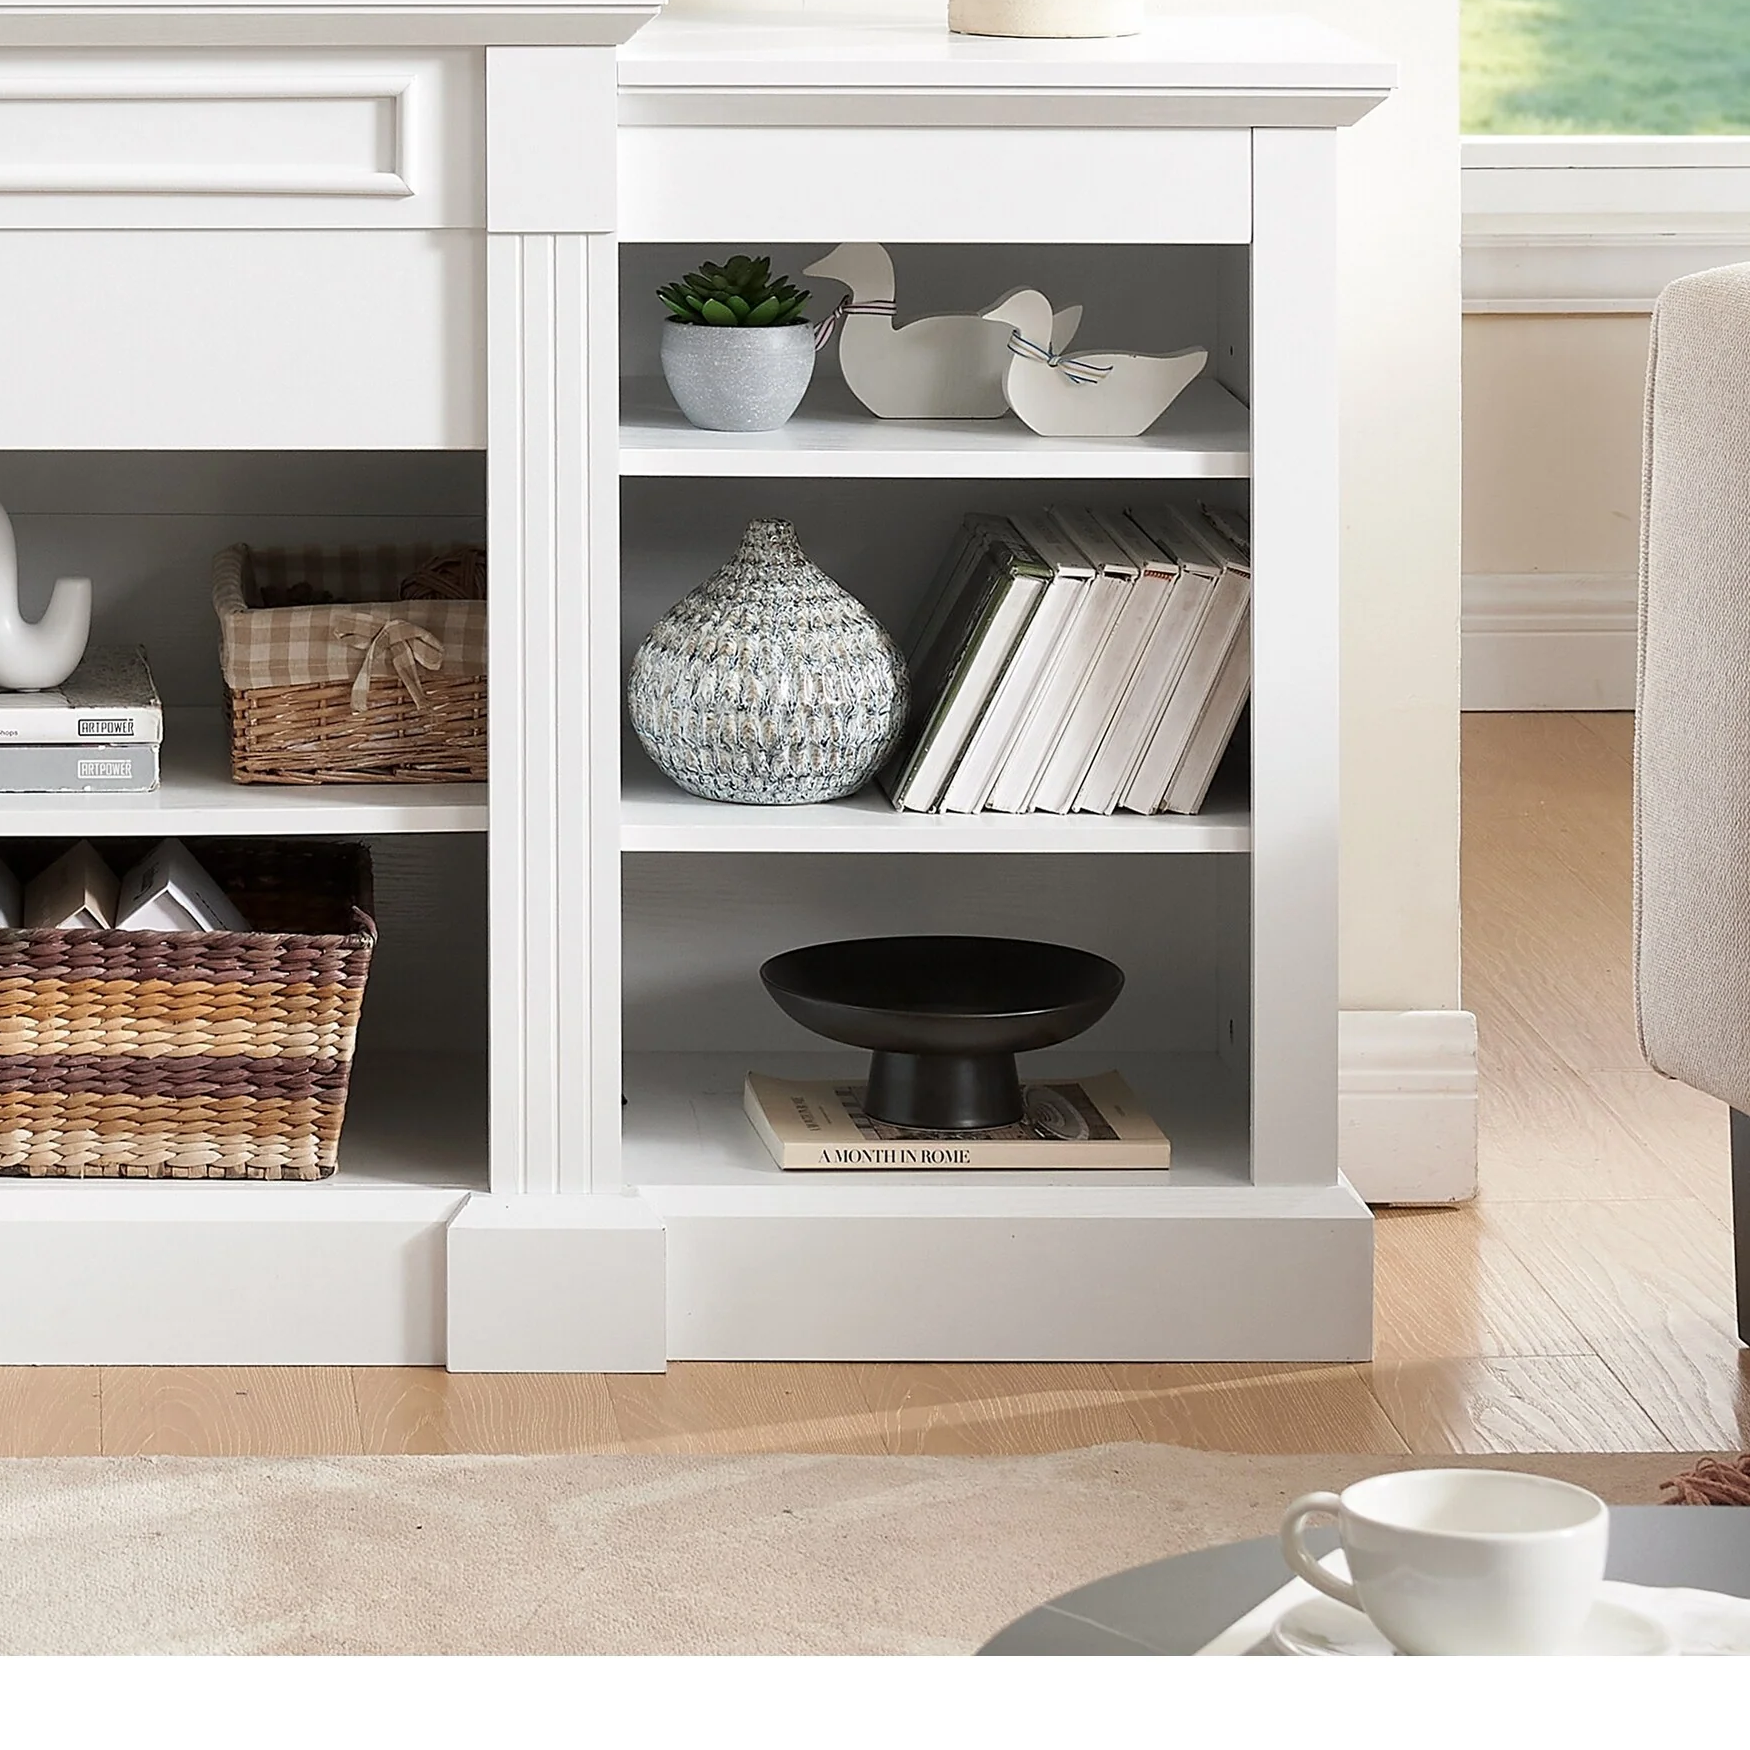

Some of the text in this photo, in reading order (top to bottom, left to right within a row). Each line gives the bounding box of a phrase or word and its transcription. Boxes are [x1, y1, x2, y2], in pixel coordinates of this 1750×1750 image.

[81, 721, 135, 734] ARTPOWER
[81, 762, 132, 776] ARTPOWER
[818, 1149, 970, 1164] A MONTH IN ROME
